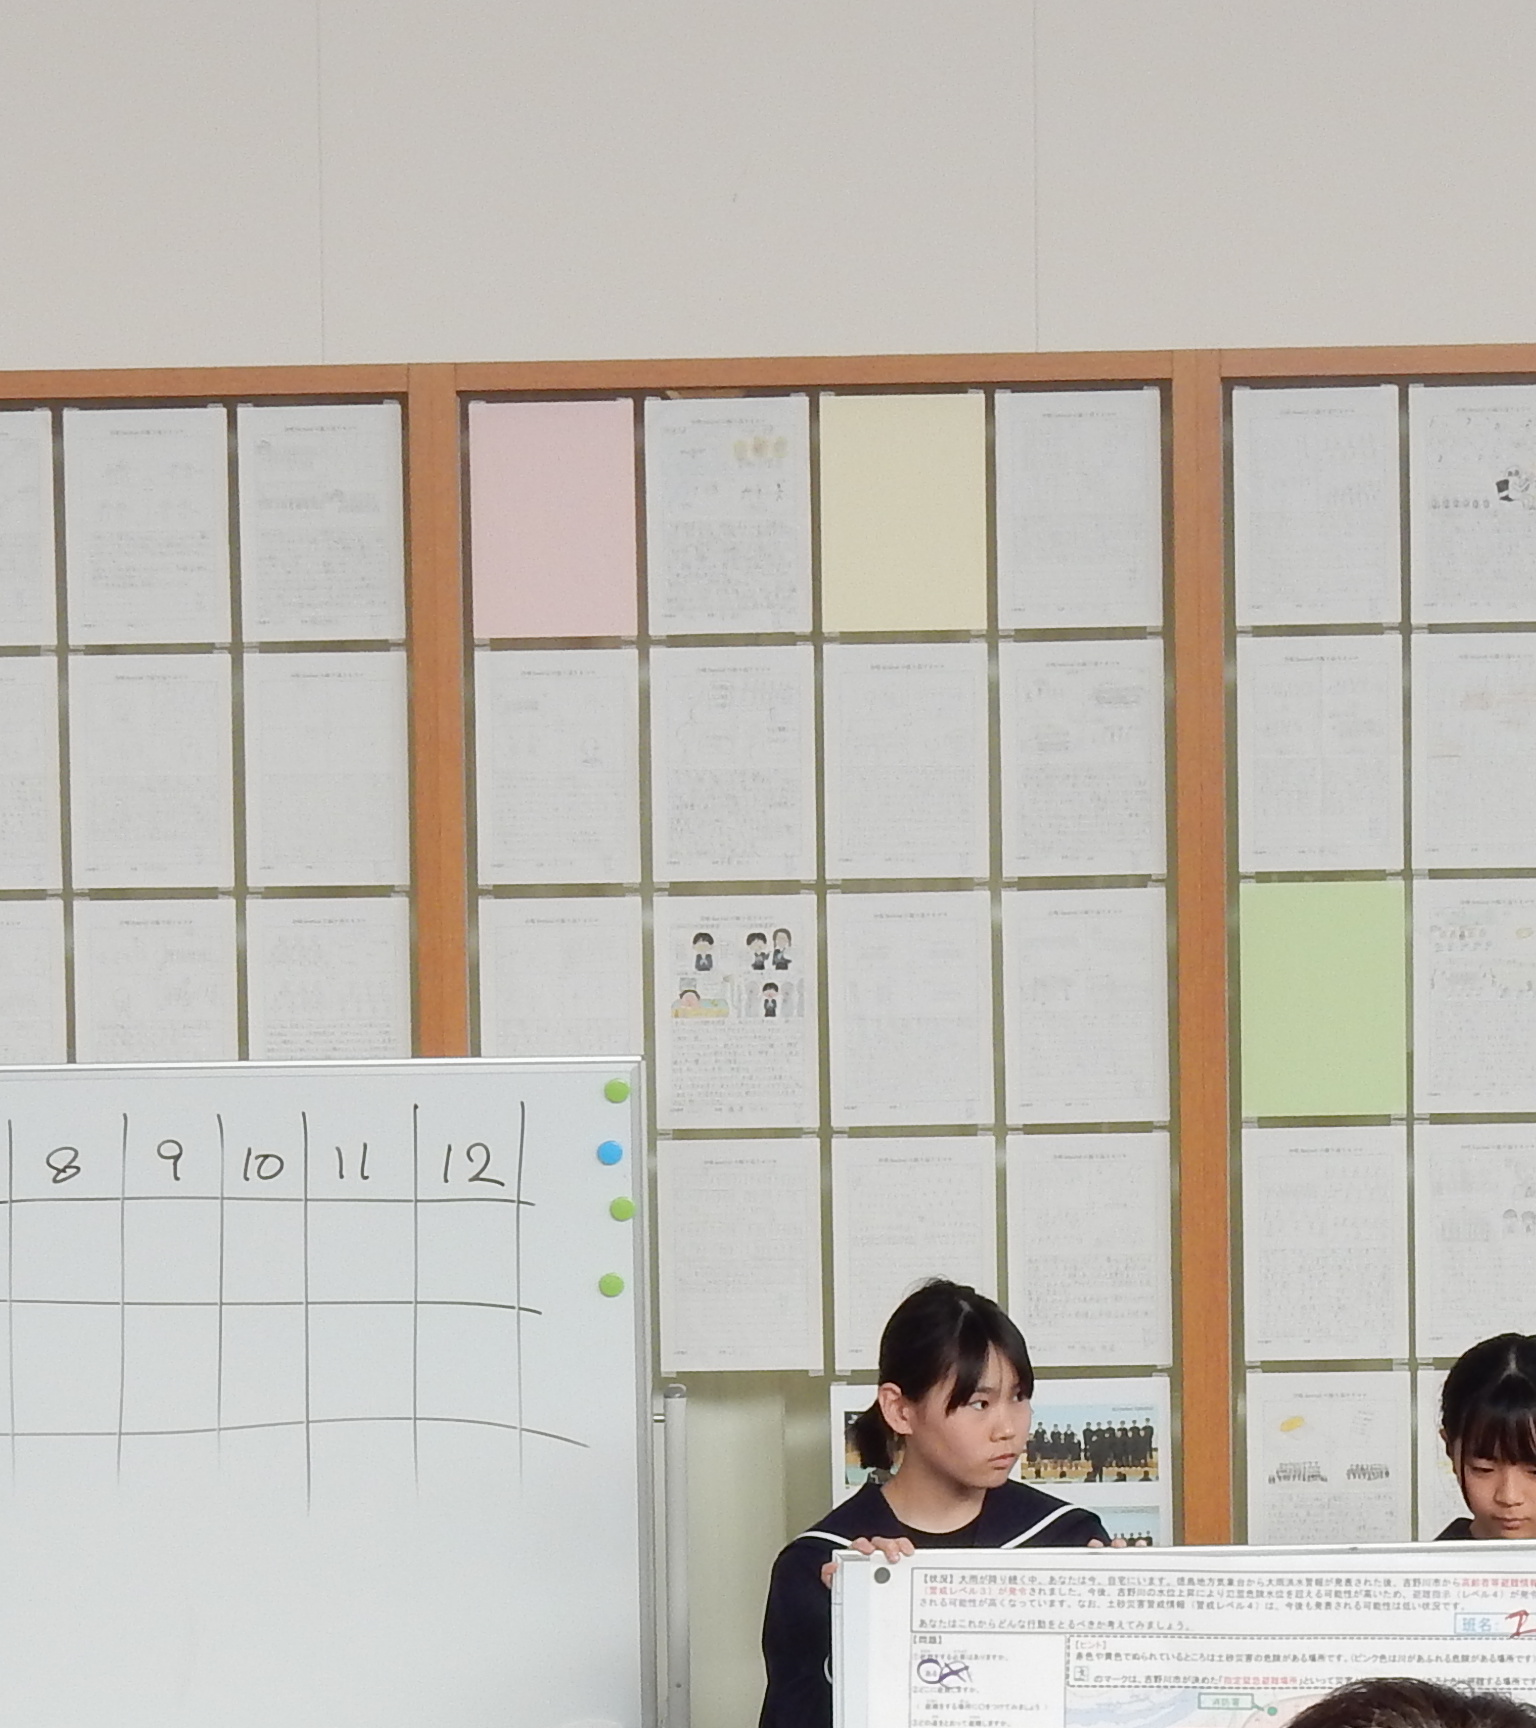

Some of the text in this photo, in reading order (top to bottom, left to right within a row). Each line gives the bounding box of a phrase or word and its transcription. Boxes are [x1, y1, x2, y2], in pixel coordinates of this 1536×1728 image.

[45, 1147, 82, 1184] 8
[156, 1138, 185, 1182] 9
[242, 1146, 285, 1182] 10
[333, 1142, 370, 1182] 11
[442, 1142, 506, 1187] 12
[1074, 1639, 1108, 1651] 【ヒント】
